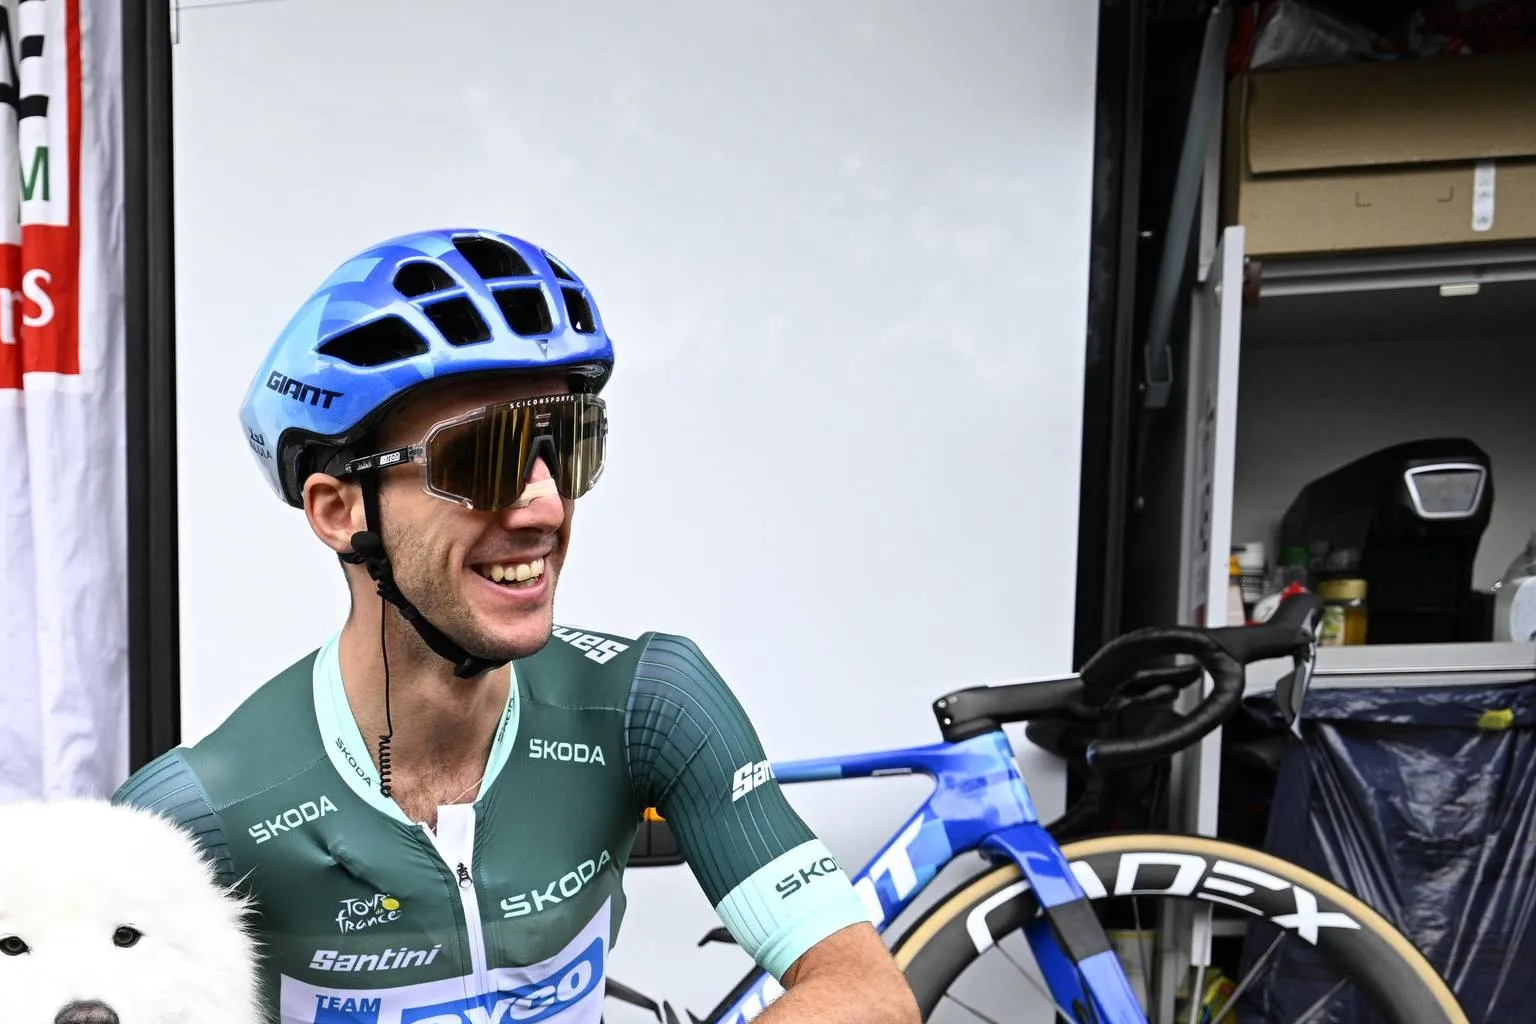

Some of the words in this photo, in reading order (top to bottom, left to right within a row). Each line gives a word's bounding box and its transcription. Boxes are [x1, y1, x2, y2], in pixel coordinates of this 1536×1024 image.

[265, 370, 344, 410] GIANT
[552, 625, 630, 665] San
[775, 856, 842, 899] SKO
[309, 943, 443, 972] Santini
[315, 994, 381, 1014] TEAM
